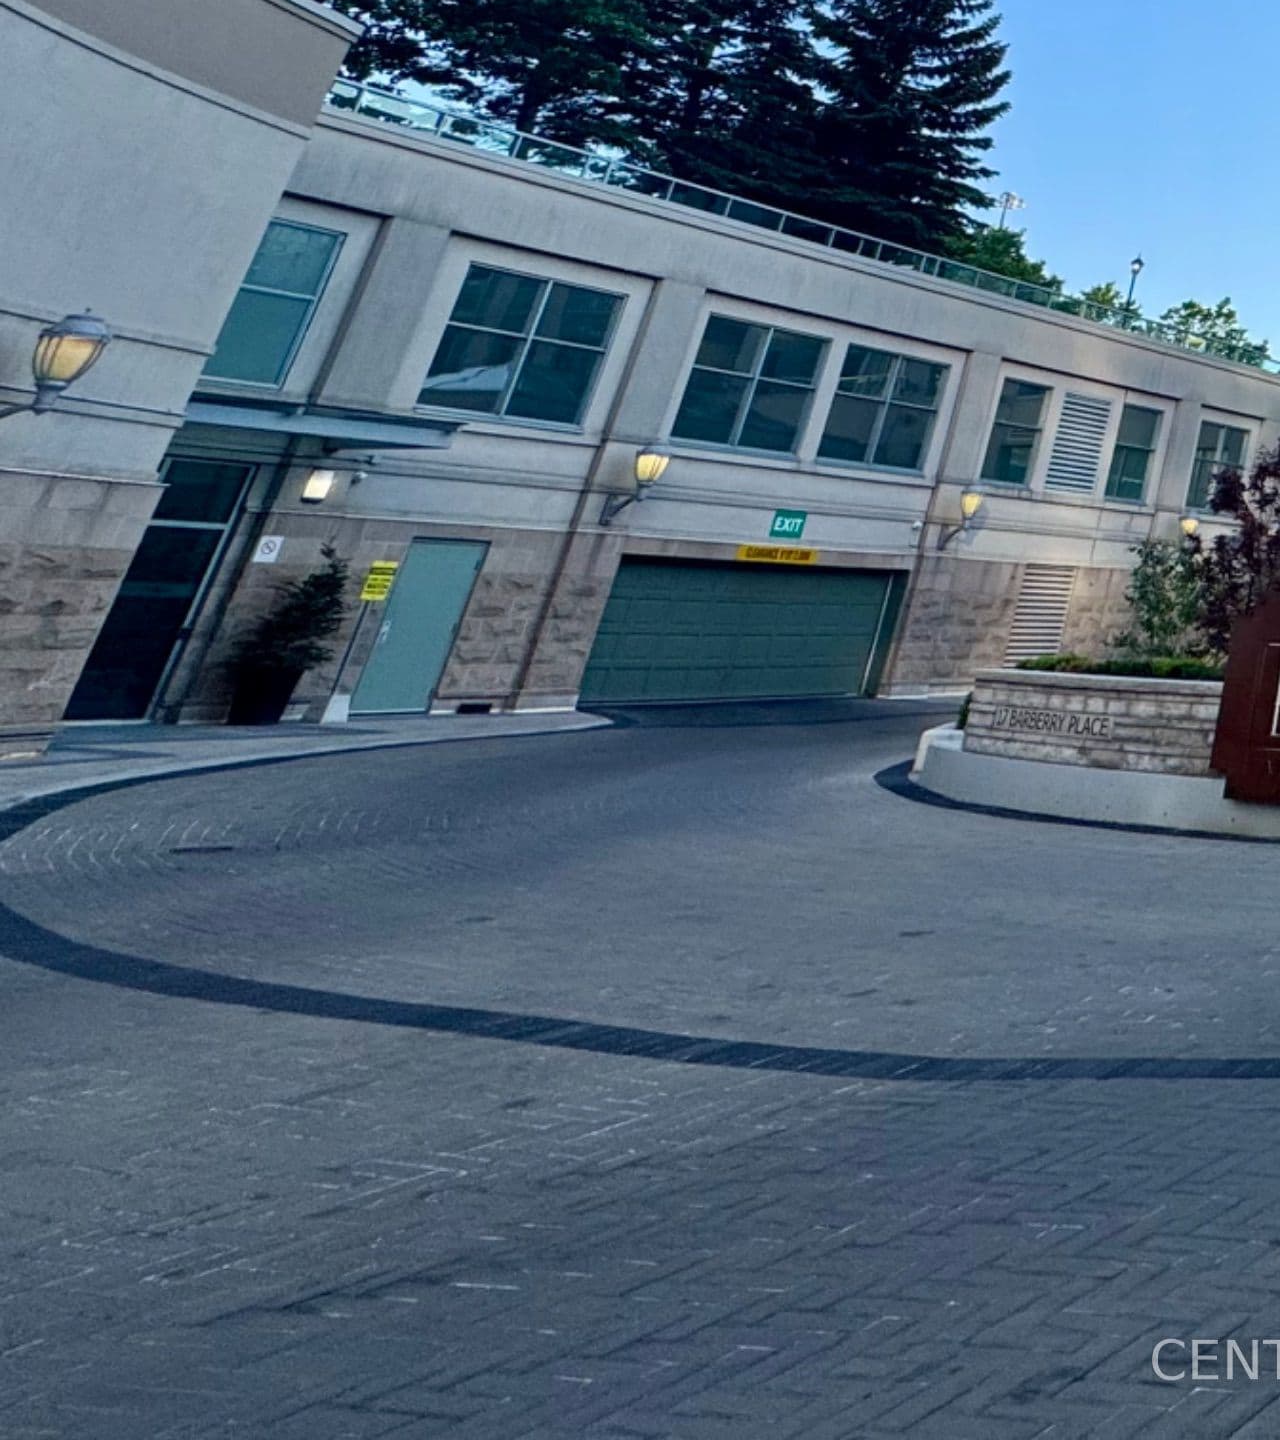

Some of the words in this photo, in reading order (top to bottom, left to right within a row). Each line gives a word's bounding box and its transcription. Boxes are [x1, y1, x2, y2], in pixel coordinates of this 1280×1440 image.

[773, 517, 803, 532] EXIT
[1008, 709, 1064, 731] BARBERRY
[1067, 715, 1110, 737] PLACE
